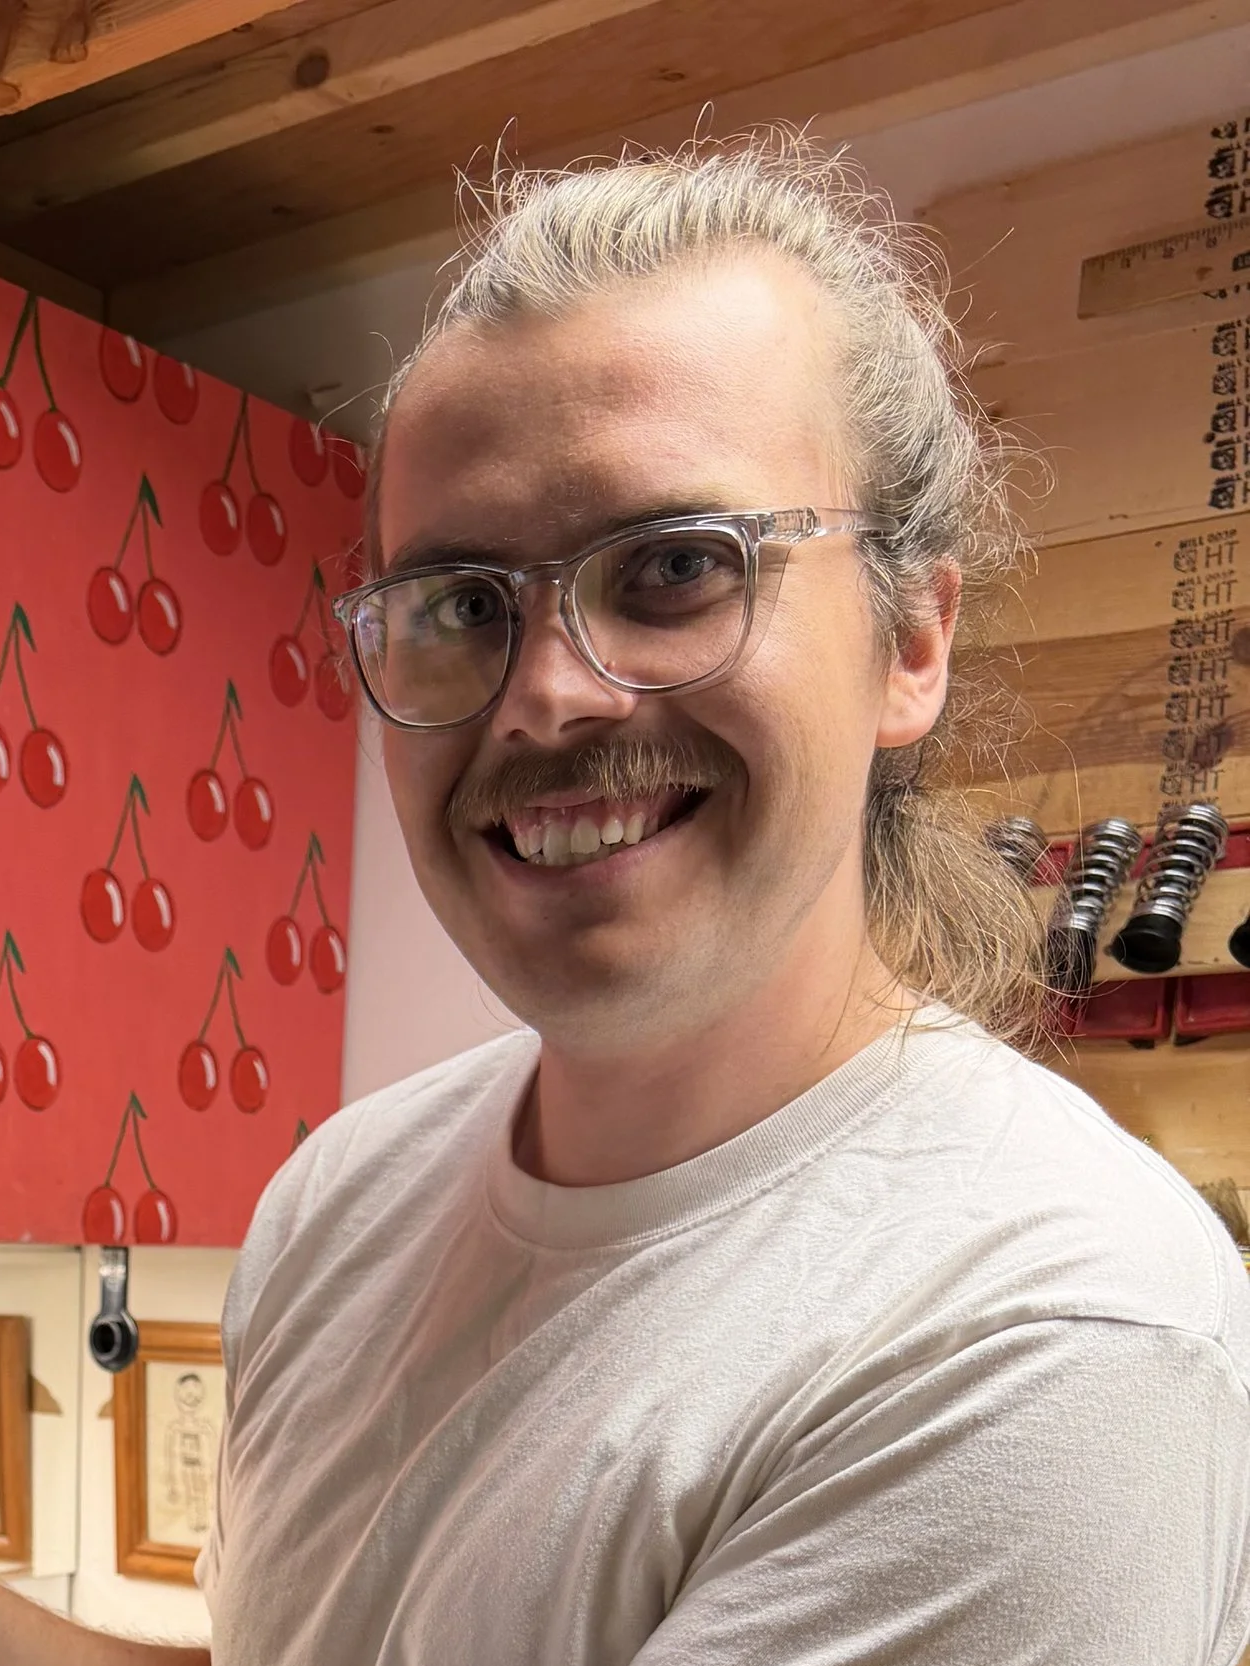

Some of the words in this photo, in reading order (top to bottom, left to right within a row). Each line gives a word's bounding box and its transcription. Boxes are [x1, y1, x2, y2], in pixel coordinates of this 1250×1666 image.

[1205, 541, 1239, 569] HT
[1203, 580, 1238, 608] HT
[1201, 618, 1236, 645] HT
[1199, 657, 1234, 682] HT
[1196, 694, 1233, 720] HT
[1190, 768, 1225, 793] HT
